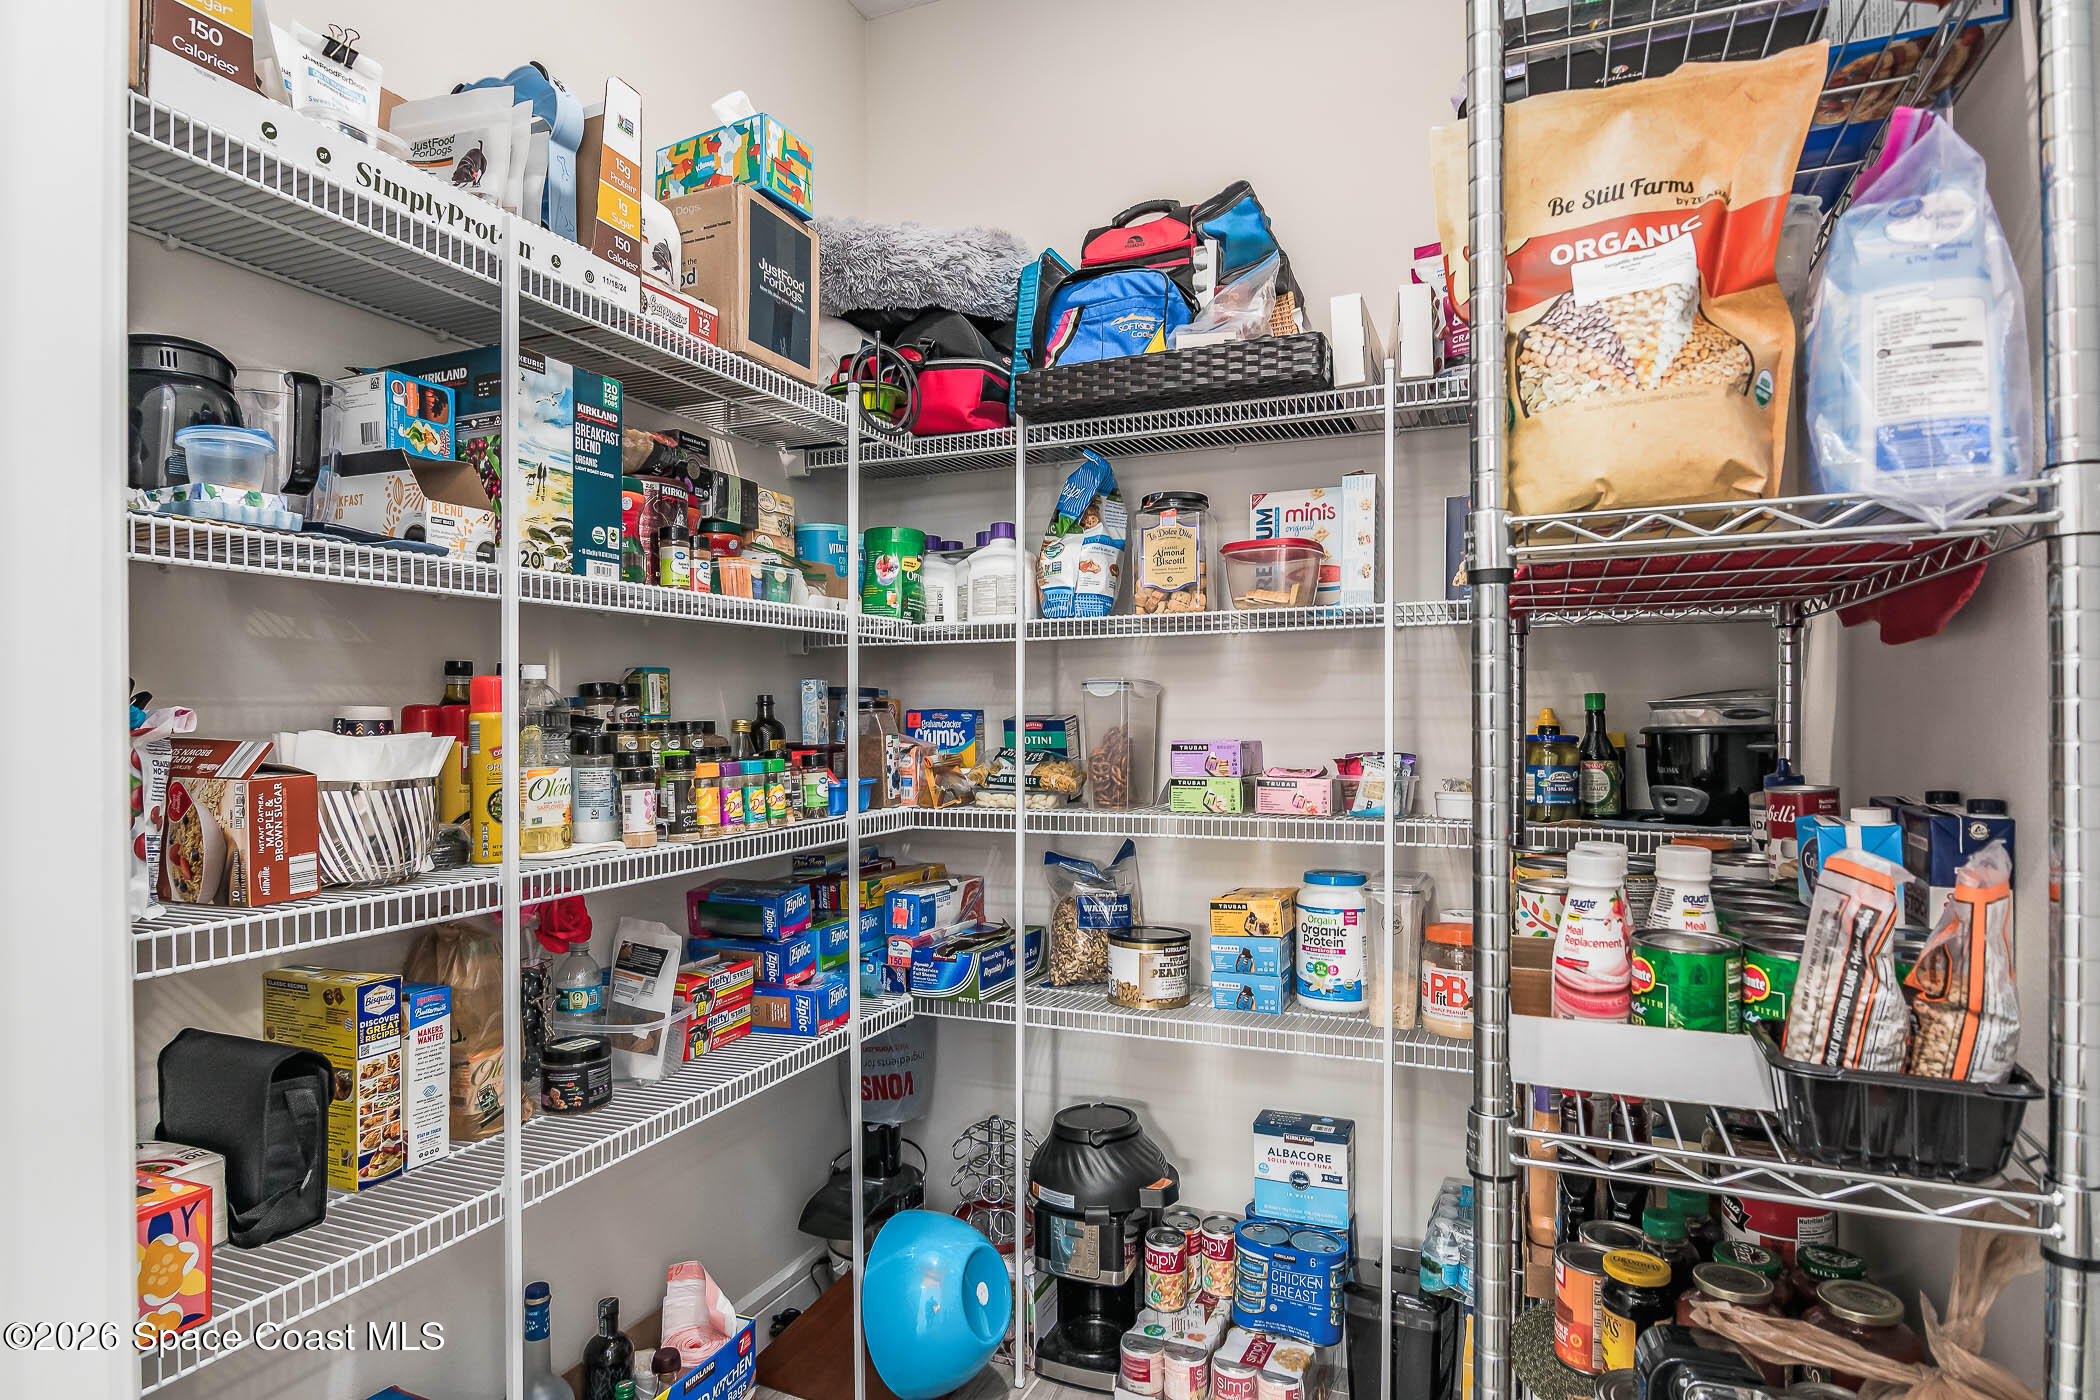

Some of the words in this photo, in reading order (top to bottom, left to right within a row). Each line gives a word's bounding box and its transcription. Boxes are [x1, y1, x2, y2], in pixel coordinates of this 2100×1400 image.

[187, 17, 223, 48] 150
[171, 35, 236, 75] Calories
[410, 133, 456, 152] JustFood
[412, 145, 453, 159] ForDogs
[614, 156, 632, 181] 15g
[610, 171, 635, 195] Protein
[1548, 197, 1575, 217] Be
[1582, 182, 1625, 211] Still
[1629, 177, 1695, 199] Farms
[1676, 197, 1690, 207] by
[355, 161, 536, 260] SimplyProtn
[617, 197, 629, 218] 1g
[611, 212, 634, 231] Sugar
[614, 235, 632, 254] 150
[1550, 215, 1703, 266] ORGANIC
[607, 249, 637, 272] Calories
[758, 257, 805, 294] JustFood
[763, 269, 803, 304] ForDogs
[693, 308, 714, 321] VARIETY
[698, 316, 710, 330] 12
[603, 382, 618, 395] 120
[577, 402, 618, 424] KIRKLAND
[575, 422, 620, 448] BREAKFAST
[575, 436, 601, 456] BLEND
[575, 454, 598, 469] ORGANIC
[662, 485, 688, 500] KIRKLA
[431, 502, 463, 518] BLEND
[1285, 502, 1336, 523] minis
[1157, 528, 1177, 538] Dolce
[1285, 520, 1315, 537] original
[829, 544, 845, 554] VITAL
[1152, 548, 1185, 558] Almond
[1152, 556, 1185, 567] Biscotti
[265, 799, 274, 808] &
[273, 782, 283, 816] SUGAR
[257, 792, 265, 823] OATMEAL
[265, 810, 274, 848] MAPLE
[274, 818, 284, 862] BROWN
[258, 866, 270, 896] Millville
[785, 896, 807, 917] Ziploc
[1083, 904, 1128, 913] WALNUTS
[1570, 898, 1596, 911] equate
[1683, 894, 1709, 908] equate
[765, 909, 774, 933] Ziploc
[860, 917, 878, 933] Ziploc
[1307, 914, 1337, 927] Orgain
[1685, 921, 1707, 931] Meal
[830, 928, 848, 947] Ziploc
[1301, 922, 1347, 938] Organic
[1566, 924, 1584, 936] Meal
[1303, 934, 1344, 948] Protein
[1564, 934, 1622, 950] Replacement
[791, 942, 812, 962] Ziploc
[767, 953, 778, 983] Ziploc
[889, 957, 902, 966] 150
[733, 969, 751, 980] STEEL
[913, 966, 938, 974] Foodservice
[1150, 968, 1190, 979] PEANU
[709, 974, 730, 988] Hefty
[830, 985, 848, 1004] Ziploc
[1430, 973, 1469, 1008] PB
[365, 993, 395, 1008] Bisquick
[715, 999, 722, 1007] 20
[1436, 992, 1447, 1007] fit
[731, 1007, 746, 1018] STEEL
[797, 996, 810, 1032] Ziploc
[1834, 1005, 1849, 1046] NORTHERN
[1843, 971, 1856, 1004] BEANS
[360, 1013, 400, 1029] DISCOVER
[366, 1020, 400, 1035] GREAT
[707, 1013, 728, 1028] Hefty
[365, 1028, 400, 1043] RECIPES
[417, 1025, 443, 1037] MAKERS
[417, 1033, 444, 1045] WANTED
[713, 1037, 720, 1046] 20
[864, 1058, 875, 1069] for
[877, 1051, 925, 1068] ingredients
[861, 1072, 914, 1101] VONS
[1285, 1134, 1314, 1143] KIRKLAND
[1267, 1147, 1333, 1164] ALBACORE
[1289, 1160, 1311, 1168] WHITE
[1271, 1261, 1291, 1270] Chunk
[1309, 1257, 1316, 1268] 6
[1271, 1271, 1323, 1290] CHICKEN
[1810, 1267, 1839, 1279] MILD
[1271, 1283, 1318, 1304] BREAST
[739, 1338, 745, 1352] 7
[685, 1361, 715, 1388] KIRKLAND
[728, 1381, 747, 1400] Bags
